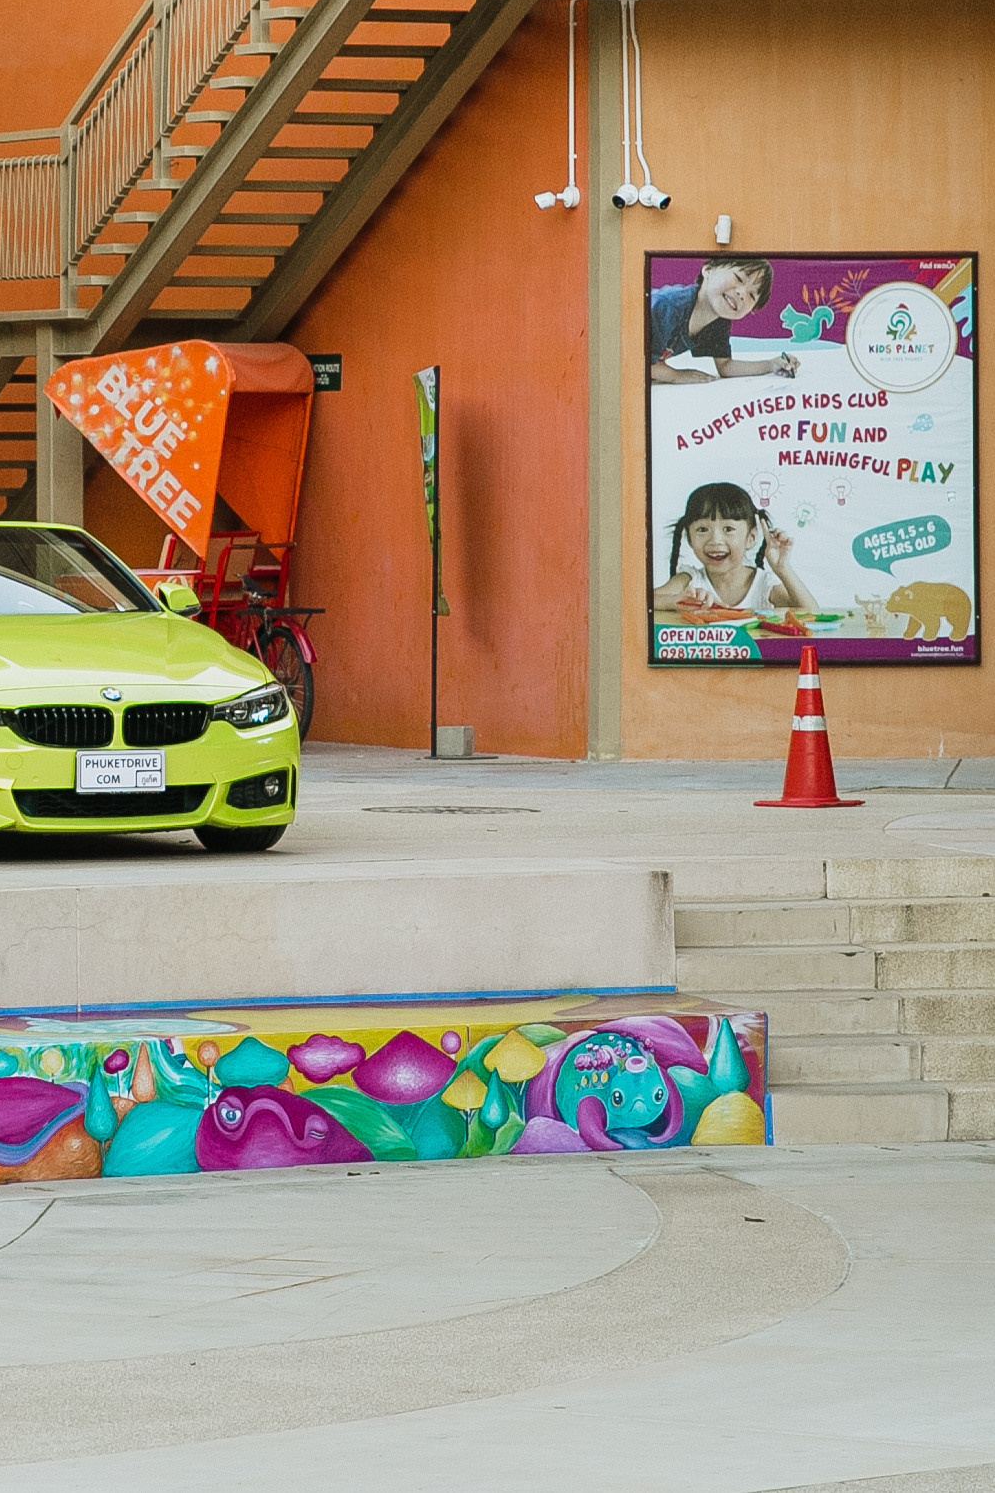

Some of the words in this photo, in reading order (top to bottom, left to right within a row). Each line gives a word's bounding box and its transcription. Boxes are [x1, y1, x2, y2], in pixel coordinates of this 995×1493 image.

[896, 344, 934, 354] PLANET
[96, 364, 186, 459] BLUE
[677, 434, 689, 450] A
[847, 390, 889, 408] CLUB
[758, 424, 791, 441] FOR
[797, 420, 847, 443] FUN
[852, 427, 888, 443] AND
[110, 429, 202, 530] TREE
[896, 457, 954, 485] PLAY
[864, 531, 896, 549] AGES
[898, 525, 916, 540] 1.5
[927, 521, 936, 533] 6
[872, 541, 913, 561] YEARS
[914, 535, 936, 551] OLD
[661, 630, 695, 642] OPEN
[661, 648, 685, 659] 098
[689, 648, 712, 659] 712
[717, 648, 749, 659] 5530
[85, 758, 158, 769] PHUKETDRIVE
[96, 775, 121, 784] COM
